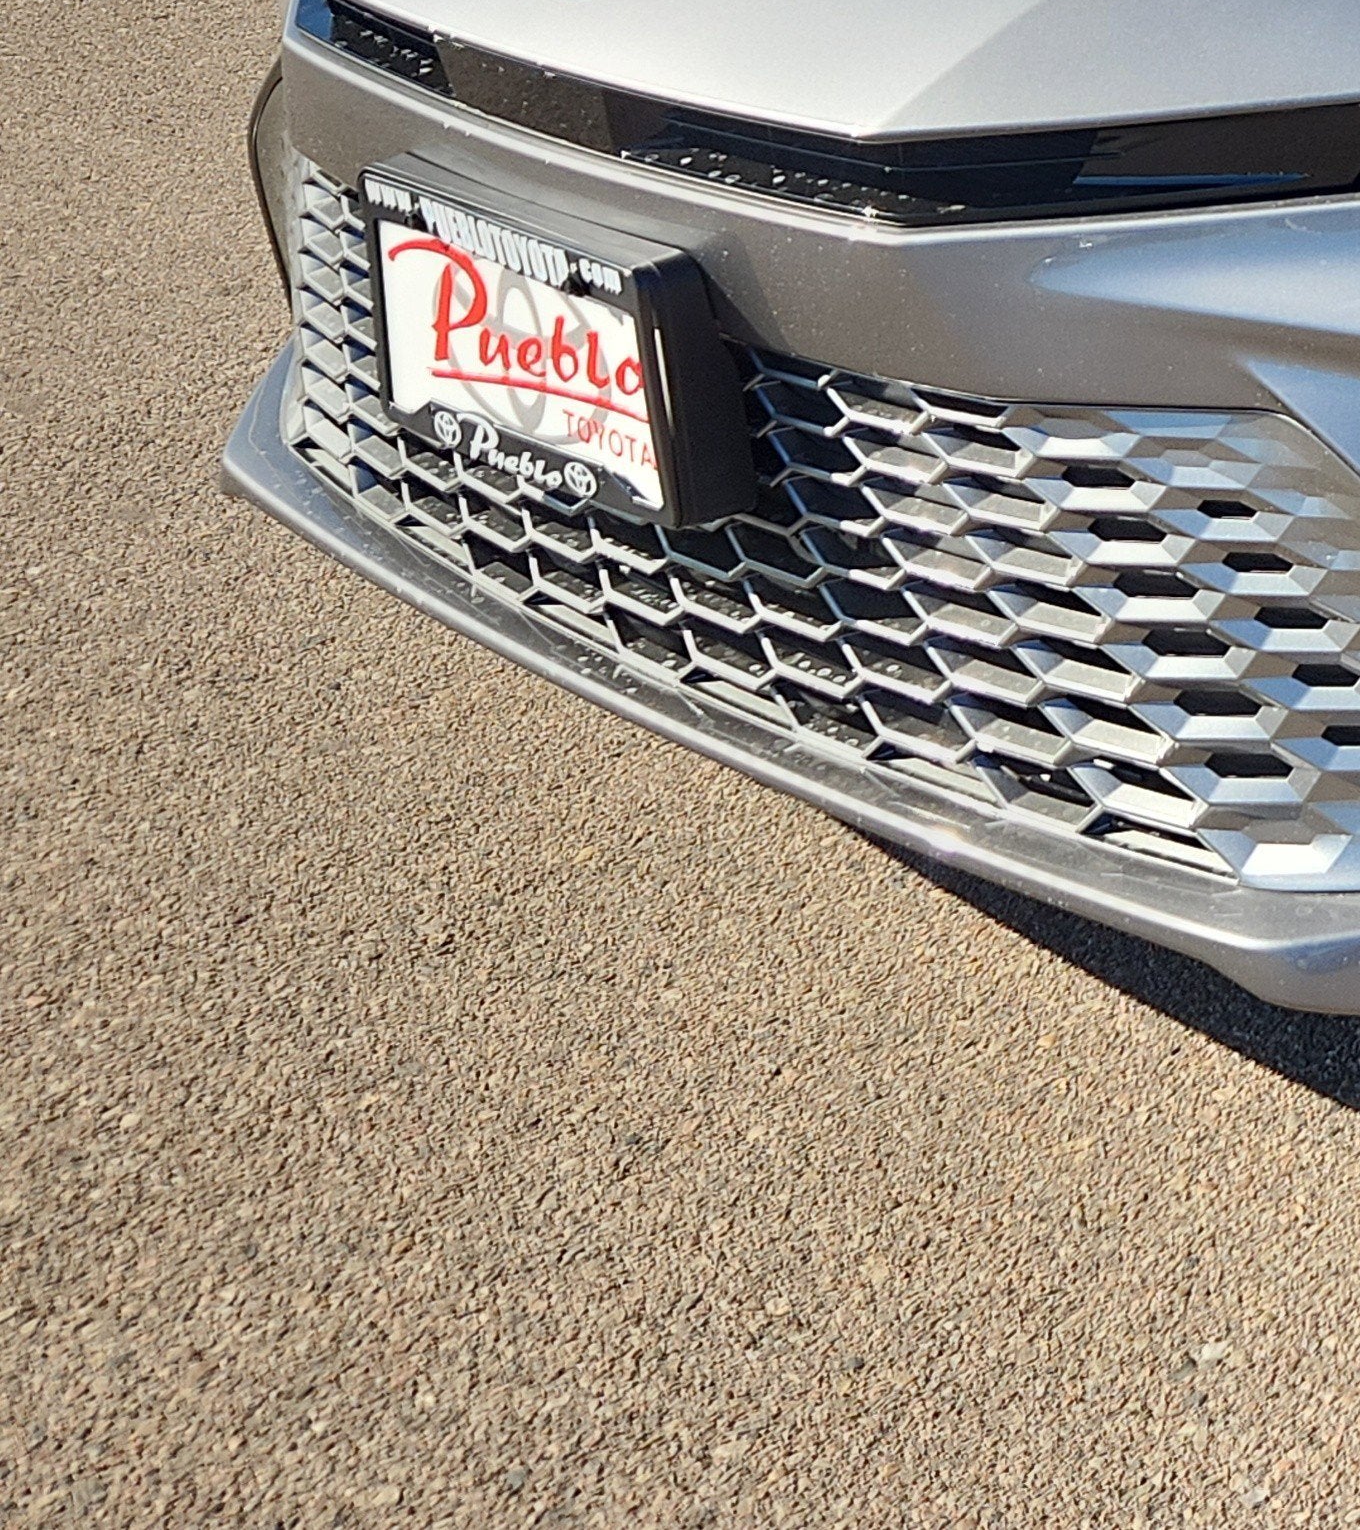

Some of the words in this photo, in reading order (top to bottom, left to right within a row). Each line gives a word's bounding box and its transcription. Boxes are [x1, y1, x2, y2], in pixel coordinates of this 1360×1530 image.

[388, 238, 644, 396] Pueblo
[456, 412, 563, 488] Pueblo
[562, 408, 657, 470] TOYOTA
